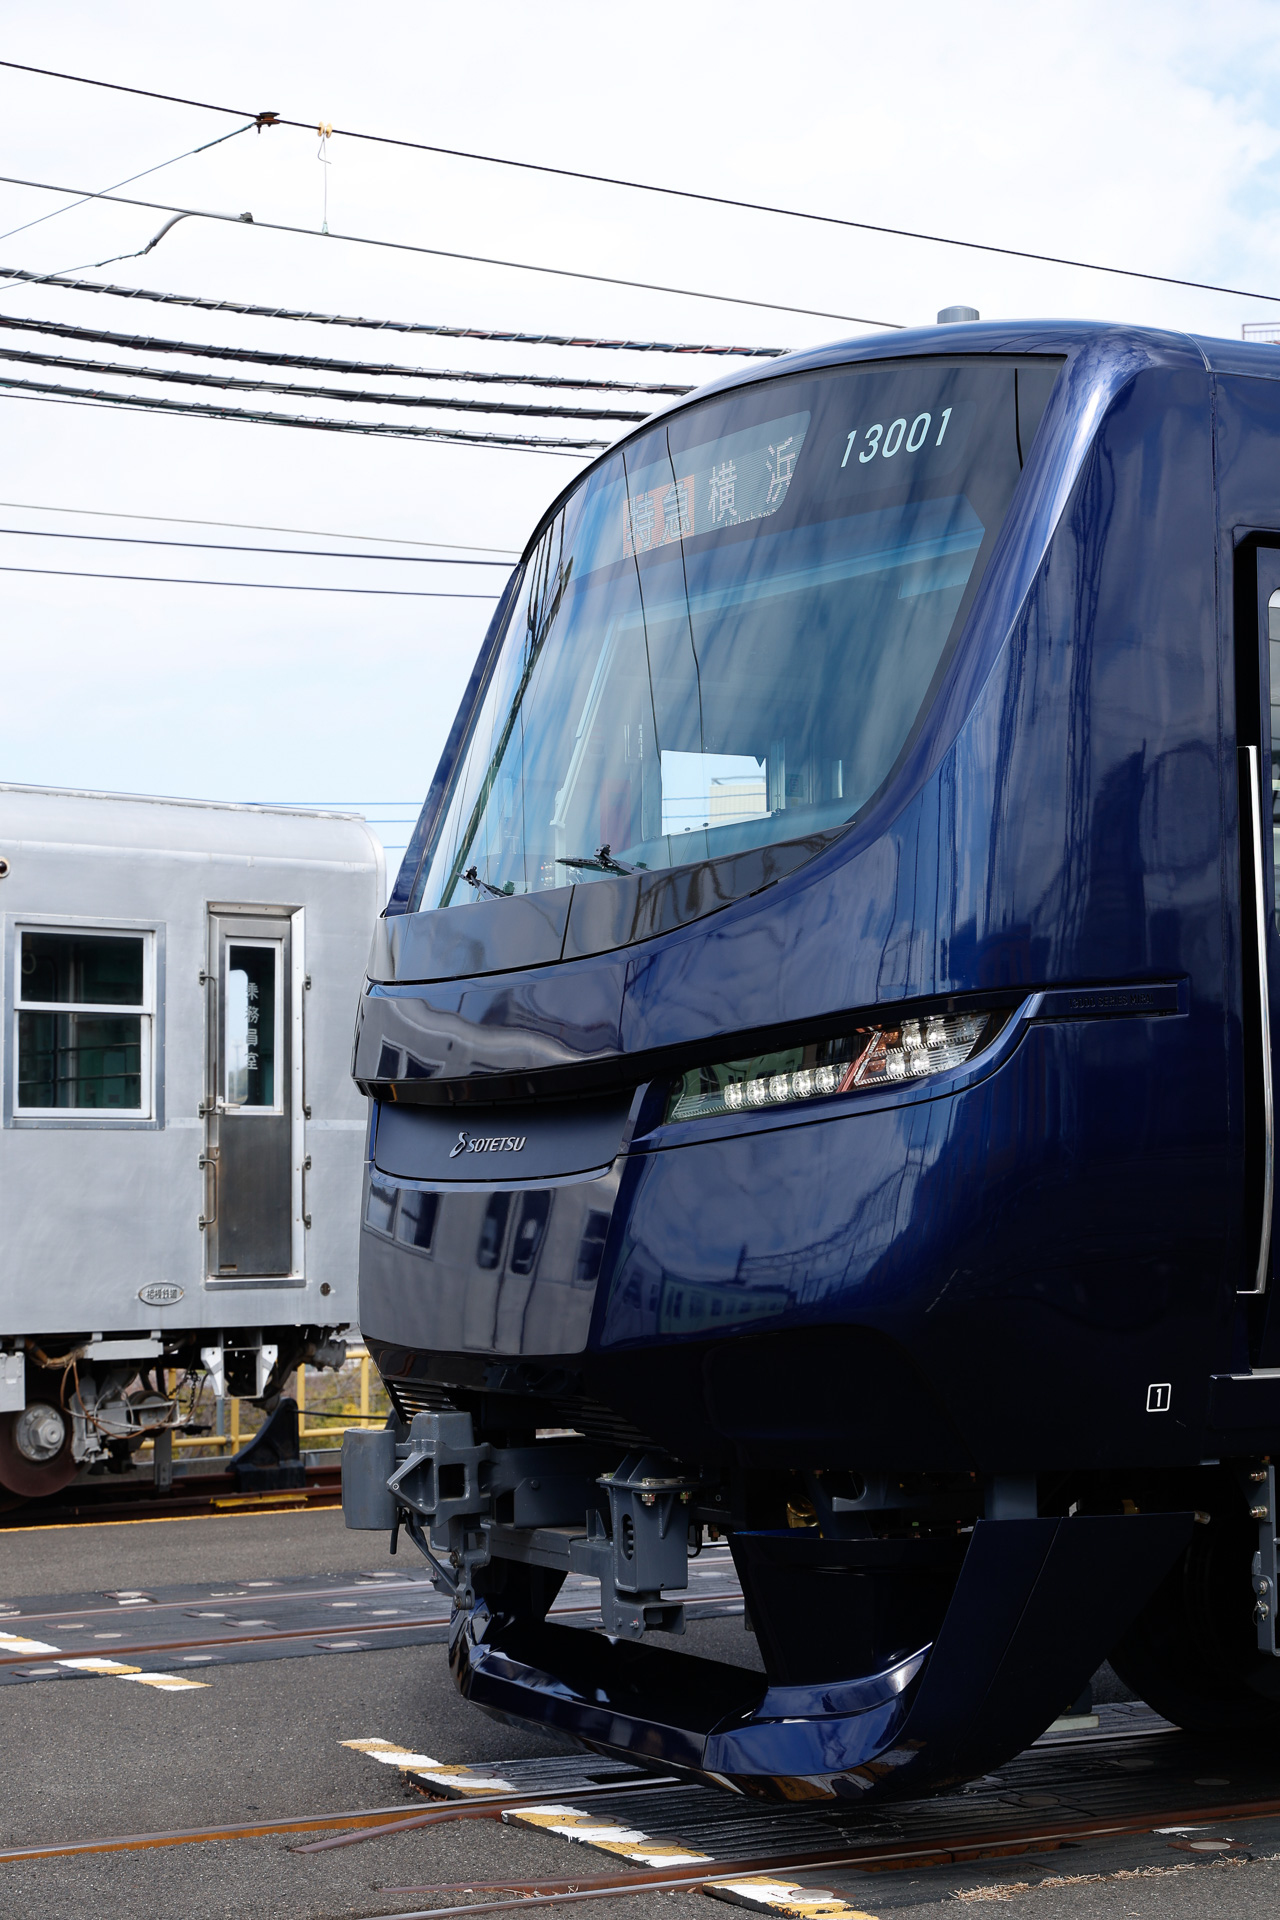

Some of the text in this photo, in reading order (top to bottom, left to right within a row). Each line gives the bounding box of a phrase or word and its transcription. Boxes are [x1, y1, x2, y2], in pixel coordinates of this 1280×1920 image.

[841, 407, 953, 468] 13001
[626, 480, 692, 552] 特急
[244, 982, 260, 1070] 乗務員室
[1097, 994, 1128, 1008] SERIES
[466, 1136, 527, 1153] SOTETSU
